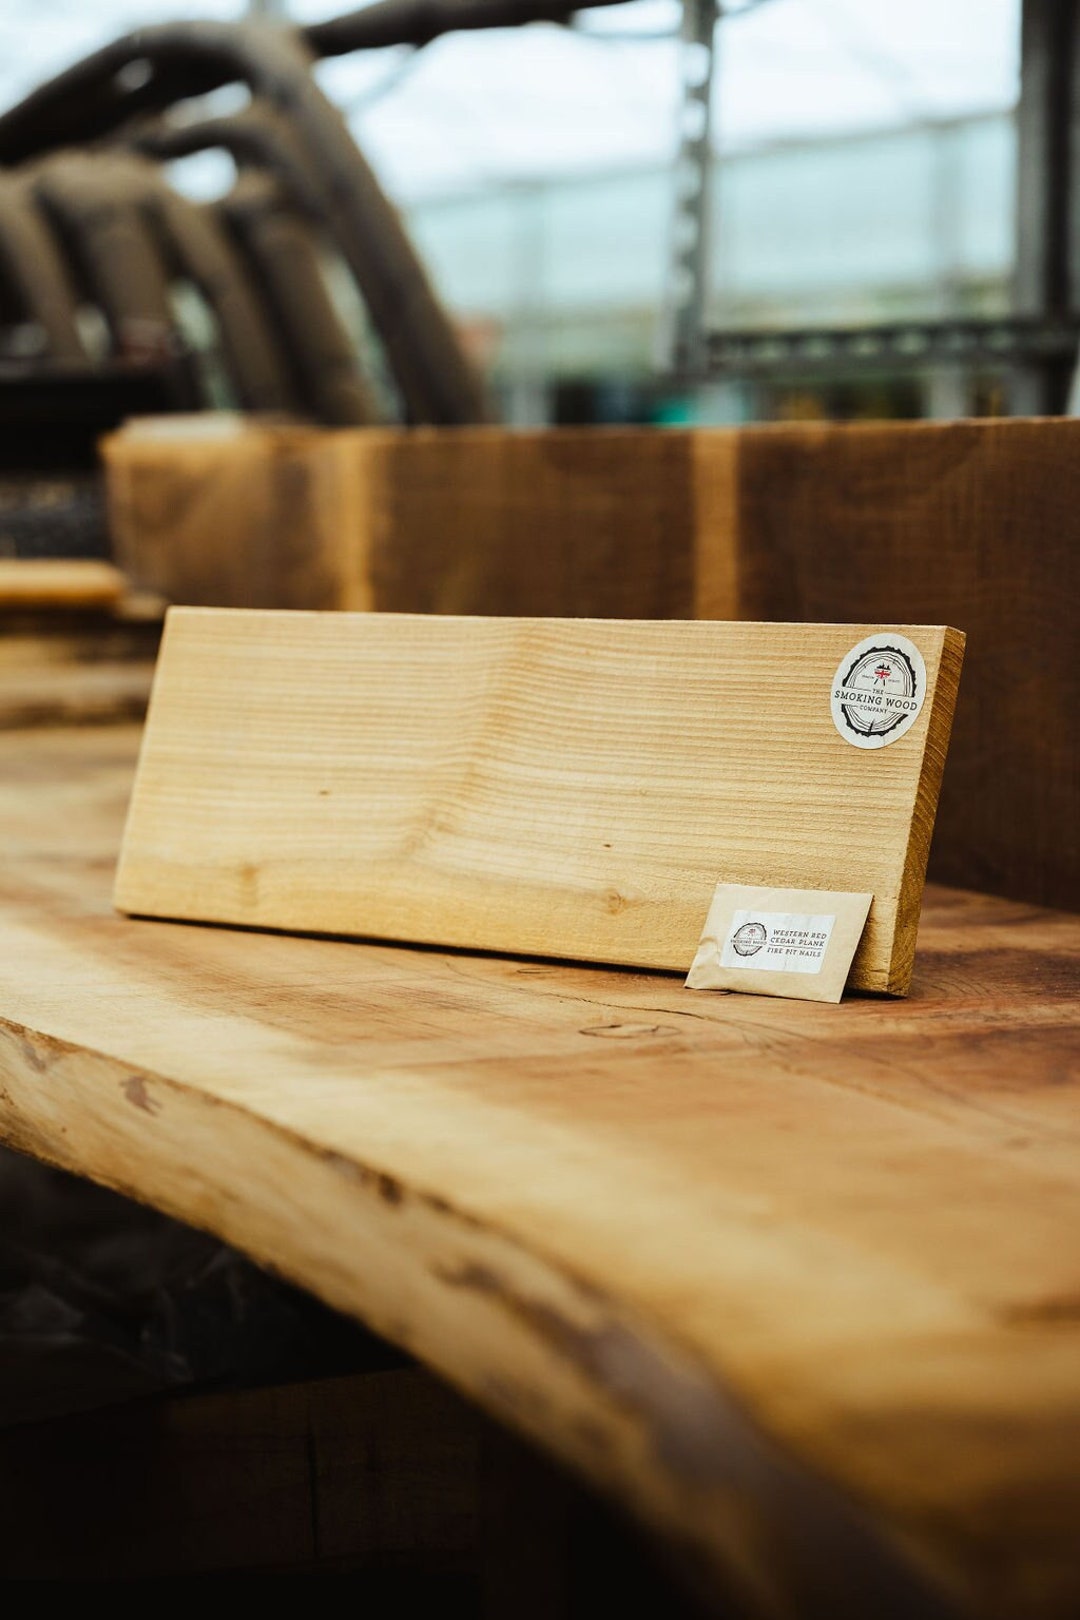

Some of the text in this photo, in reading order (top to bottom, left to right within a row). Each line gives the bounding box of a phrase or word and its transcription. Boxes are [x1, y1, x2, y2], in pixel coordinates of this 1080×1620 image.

[834, 690, 918, 711] SMOKING WOOD
[860, 705, 888, 714] COMPANY
[773, 929, 827, 940] WESTERN RED
[770, 937, 795, 945] CEDAR
[799, 939, 825, 947] PLANK
